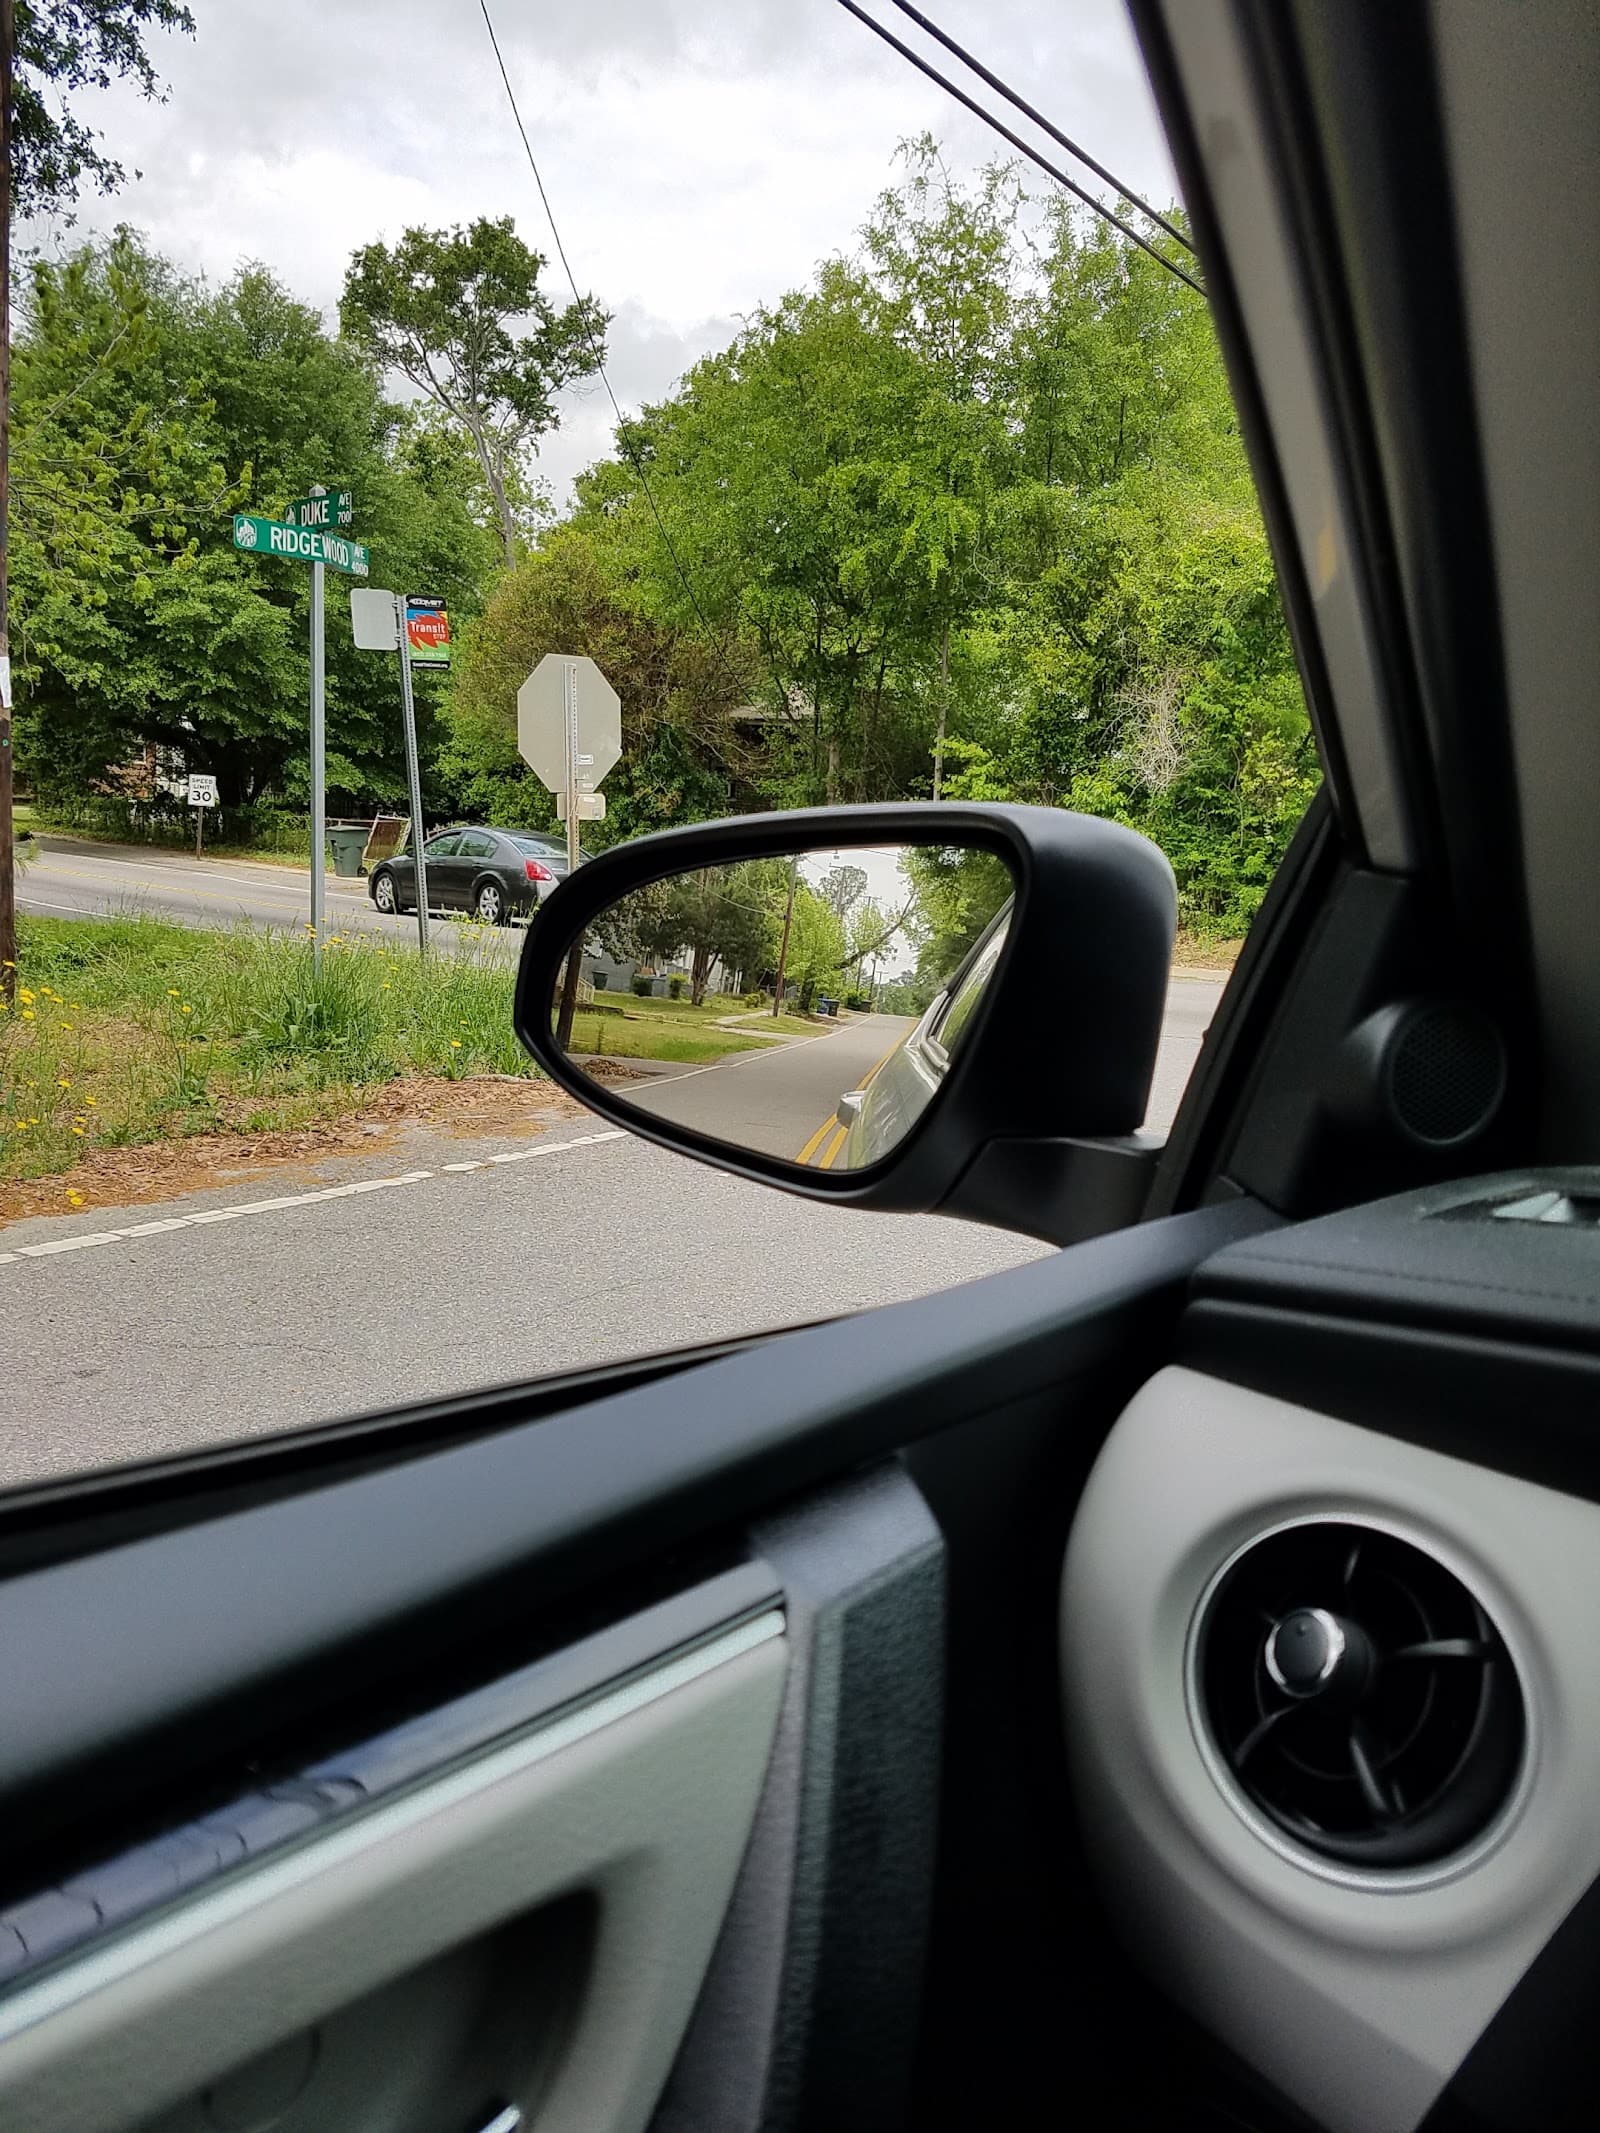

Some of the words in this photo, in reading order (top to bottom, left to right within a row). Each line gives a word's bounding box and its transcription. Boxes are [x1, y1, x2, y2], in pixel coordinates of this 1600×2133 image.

[338, 492, 350, 507] AVE
[301, 500, 330, 527] DUKE
[270, 525, 349, 567] RIDGEWOOD
[353, 546, 366, 560] AVE
[409, 621, 446, 634] Transit
[191, 777, 213, 785] SPEED
[192, 790, 212, 802] 30
